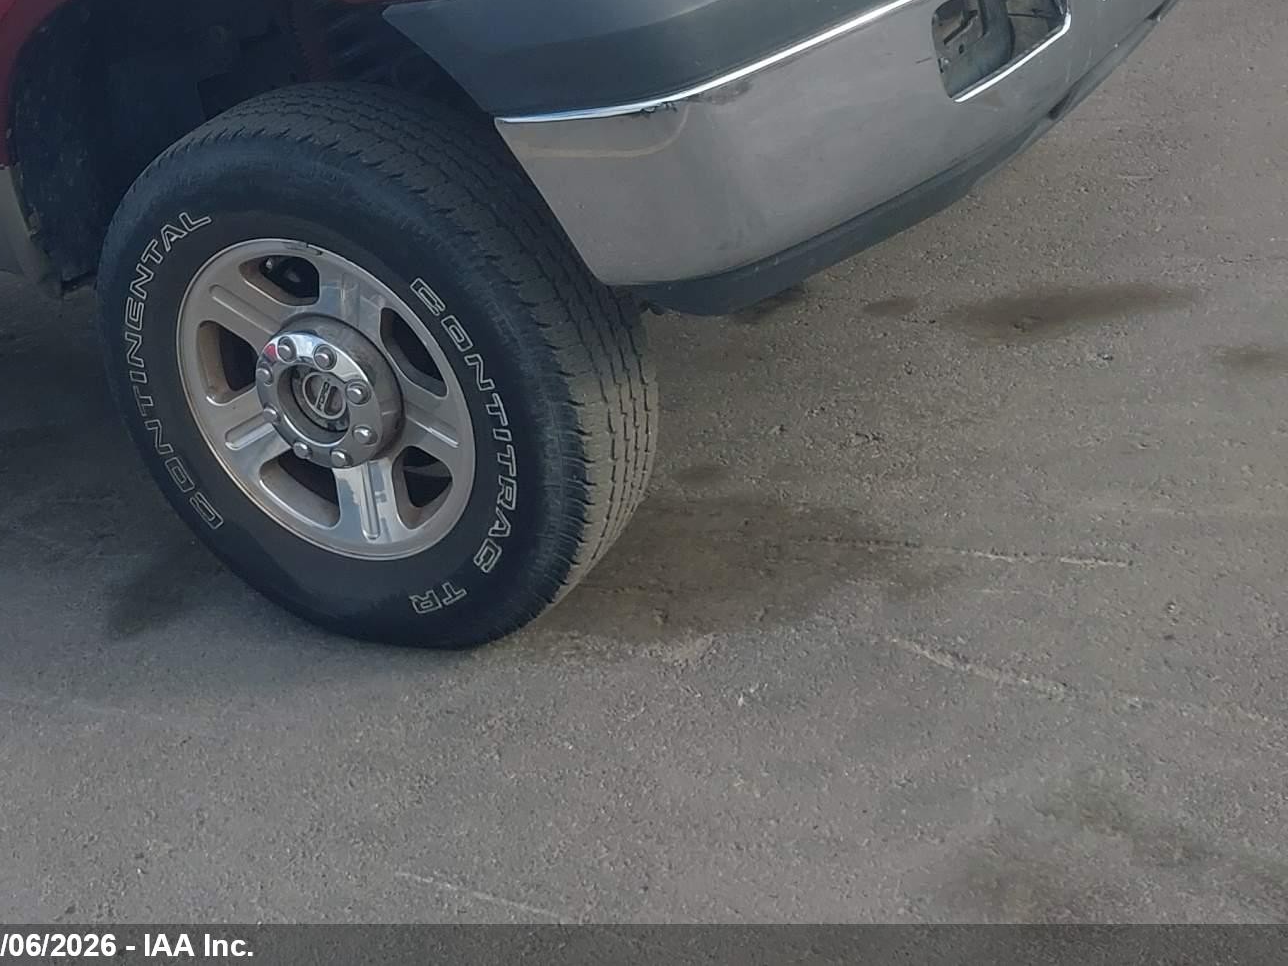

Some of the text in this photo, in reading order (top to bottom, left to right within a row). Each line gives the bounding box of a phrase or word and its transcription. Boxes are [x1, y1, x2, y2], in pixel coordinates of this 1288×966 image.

[124, 211, 225, 529] CONTINENTAL
[409, 277, 517, 615] CONTITRAC TR
